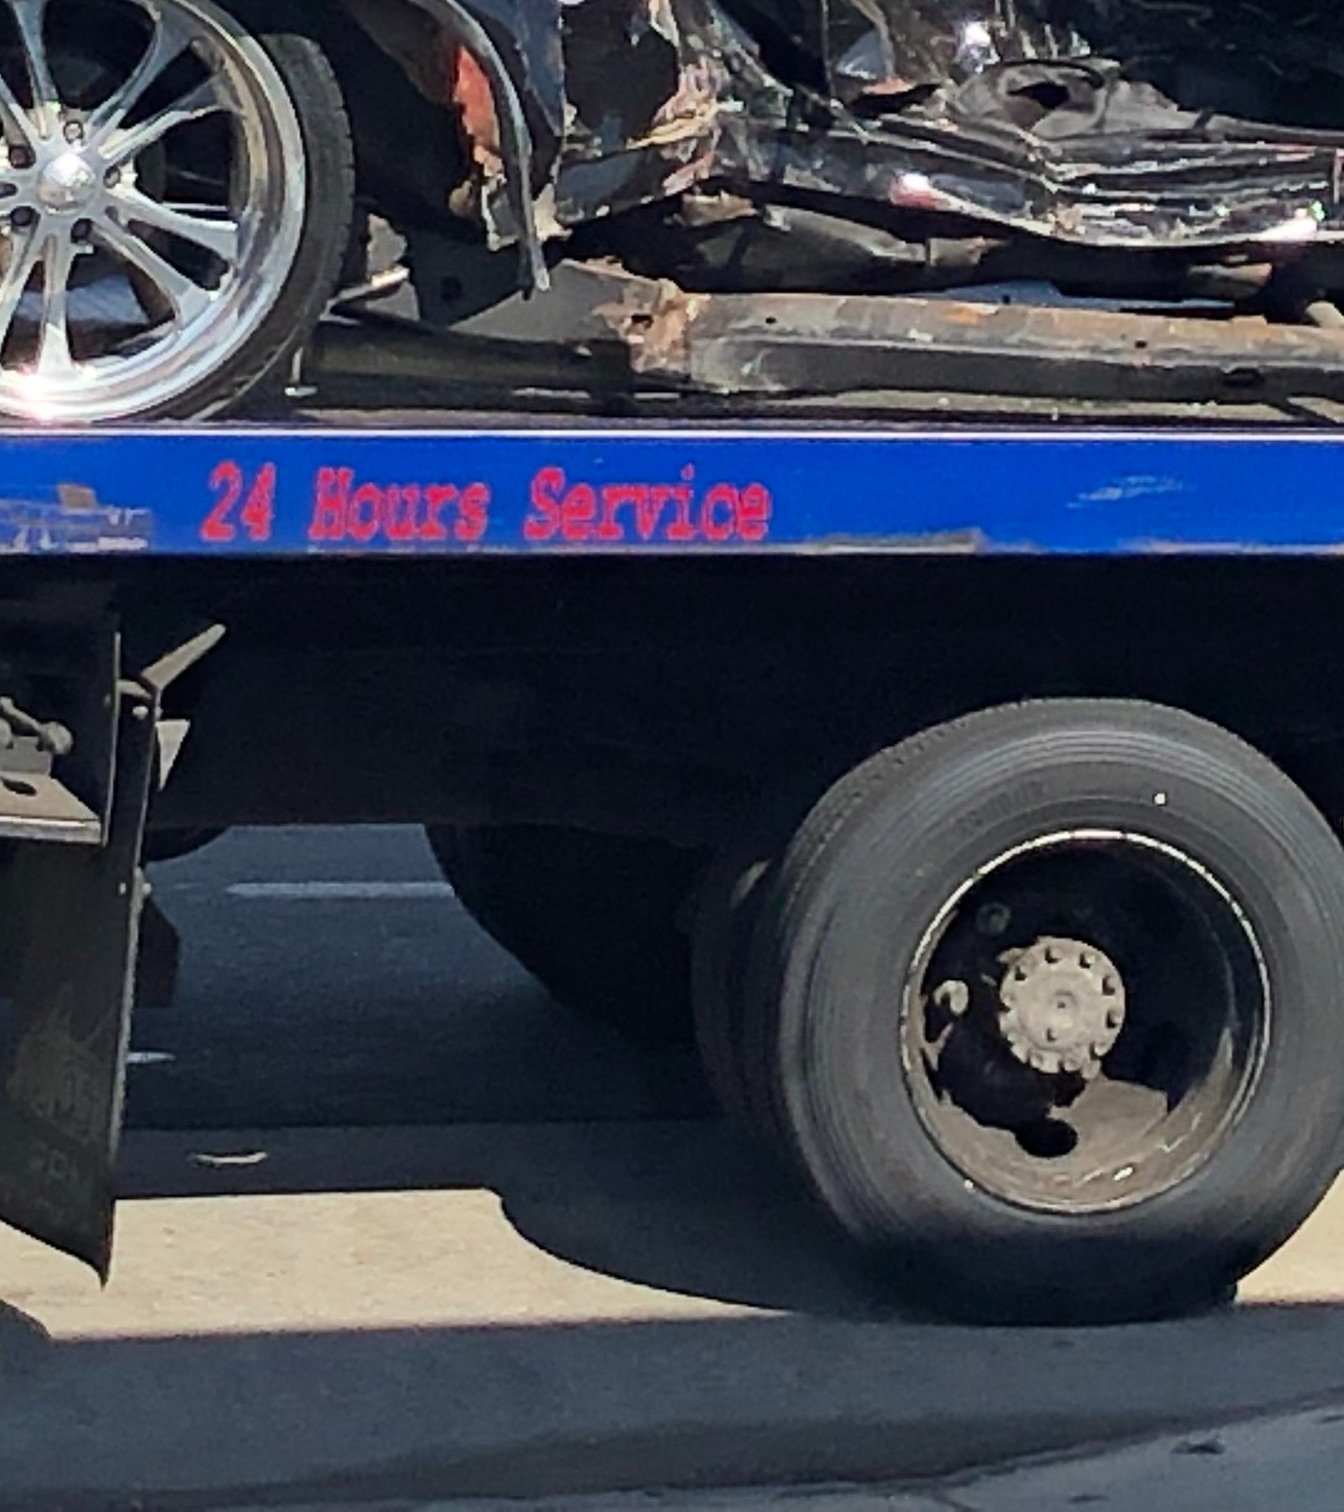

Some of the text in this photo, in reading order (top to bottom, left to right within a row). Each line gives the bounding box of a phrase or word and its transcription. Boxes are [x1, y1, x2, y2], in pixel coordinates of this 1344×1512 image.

[199, 459, 773, 542] 24 Hours Service
